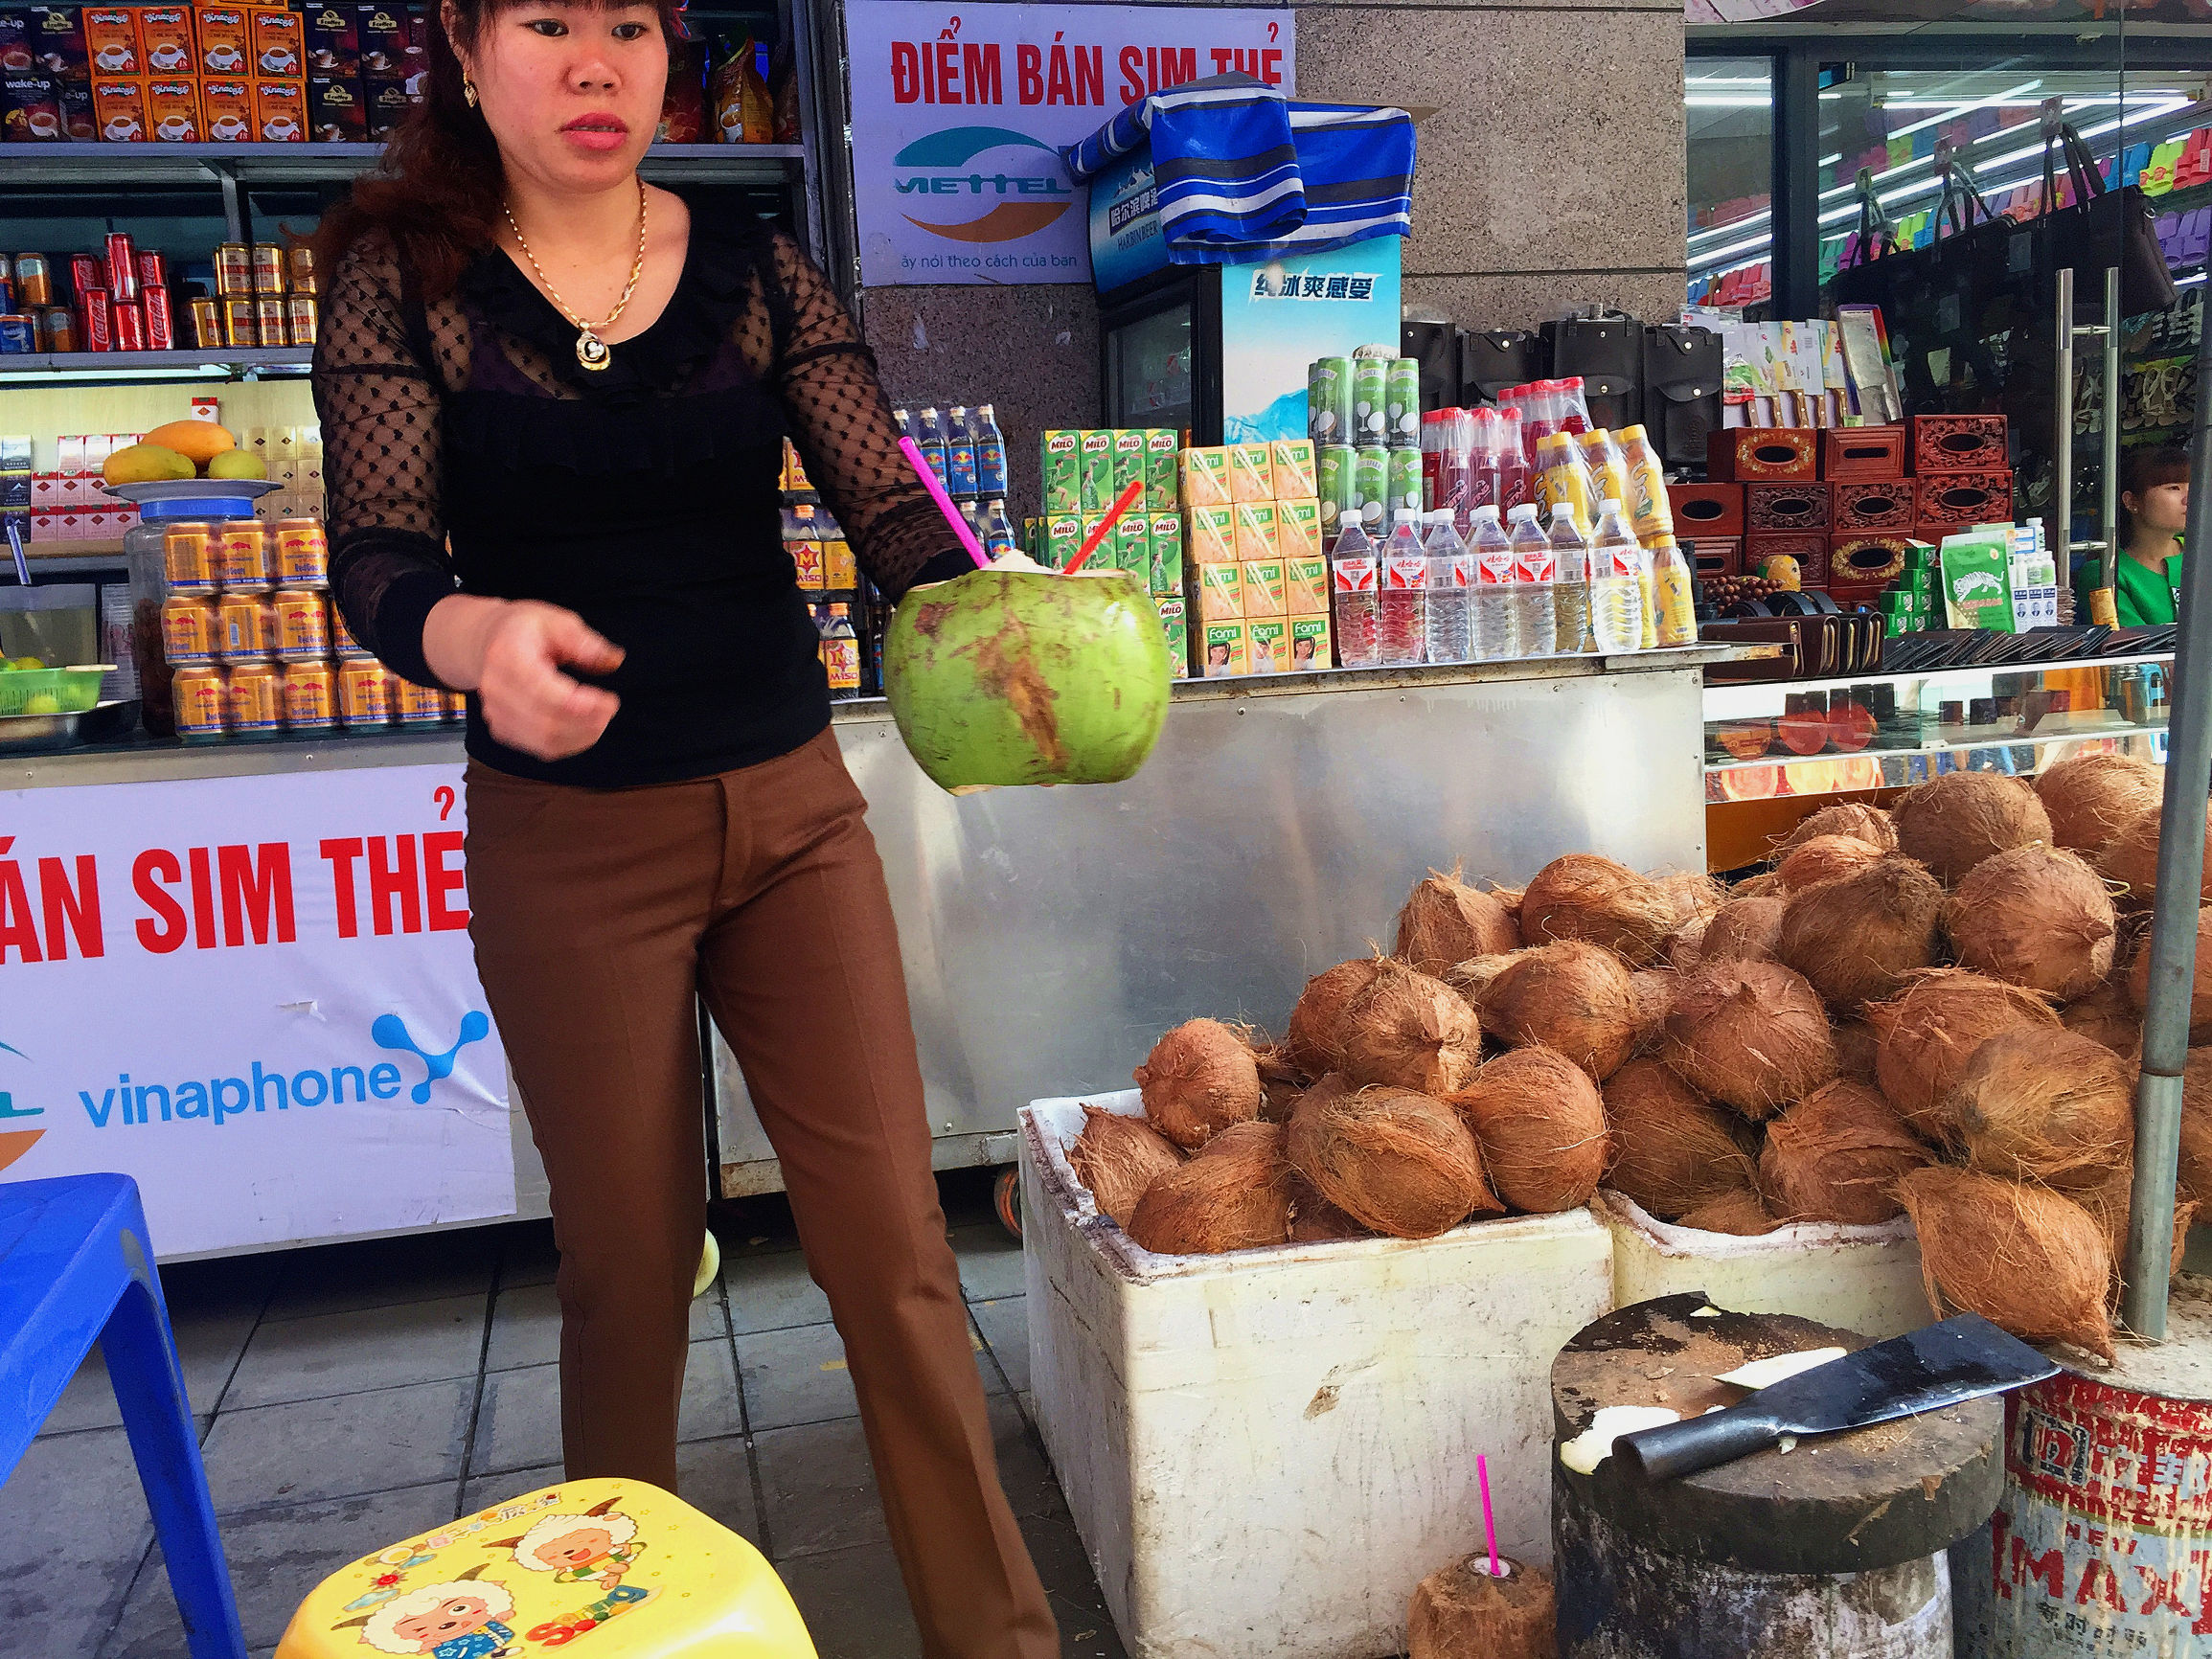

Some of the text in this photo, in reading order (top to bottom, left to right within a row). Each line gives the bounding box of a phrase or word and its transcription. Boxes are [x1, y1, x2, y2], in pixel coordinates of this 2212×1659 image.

[125, 60, 135, 69] 18
[179, 59, 188, 68] 18
[891, 16, 1283, 106] ĐIỂM BÁN SIM THẺ
[6, 80, 51, 91] wake-up
[893, 173, 1072, 194] VIETTEL
[1118, 221, 1158, 252] HARBIN BEER
[946, 255, 981, 268] theo
[985, 254, 1018, 268] cách
[1051, 440, 1074, 450] MILO
[1085, 440, 1107, 450] MILO
[1118, 440, 1140, 449] MILO
[1151, 440, 1172, 449] MILO
[1053, 525, 1075, 535] MILO
[1122, 524, 1144, 534] MILO
[1155, 523, 1176, 533] MILO
[1160, 606, 1181, 616] MILO
[131, 841, 297, 954] SIM
[319, 785, 470, 939] THẺ
[79, 1061, 401, 1128] vinaphone
